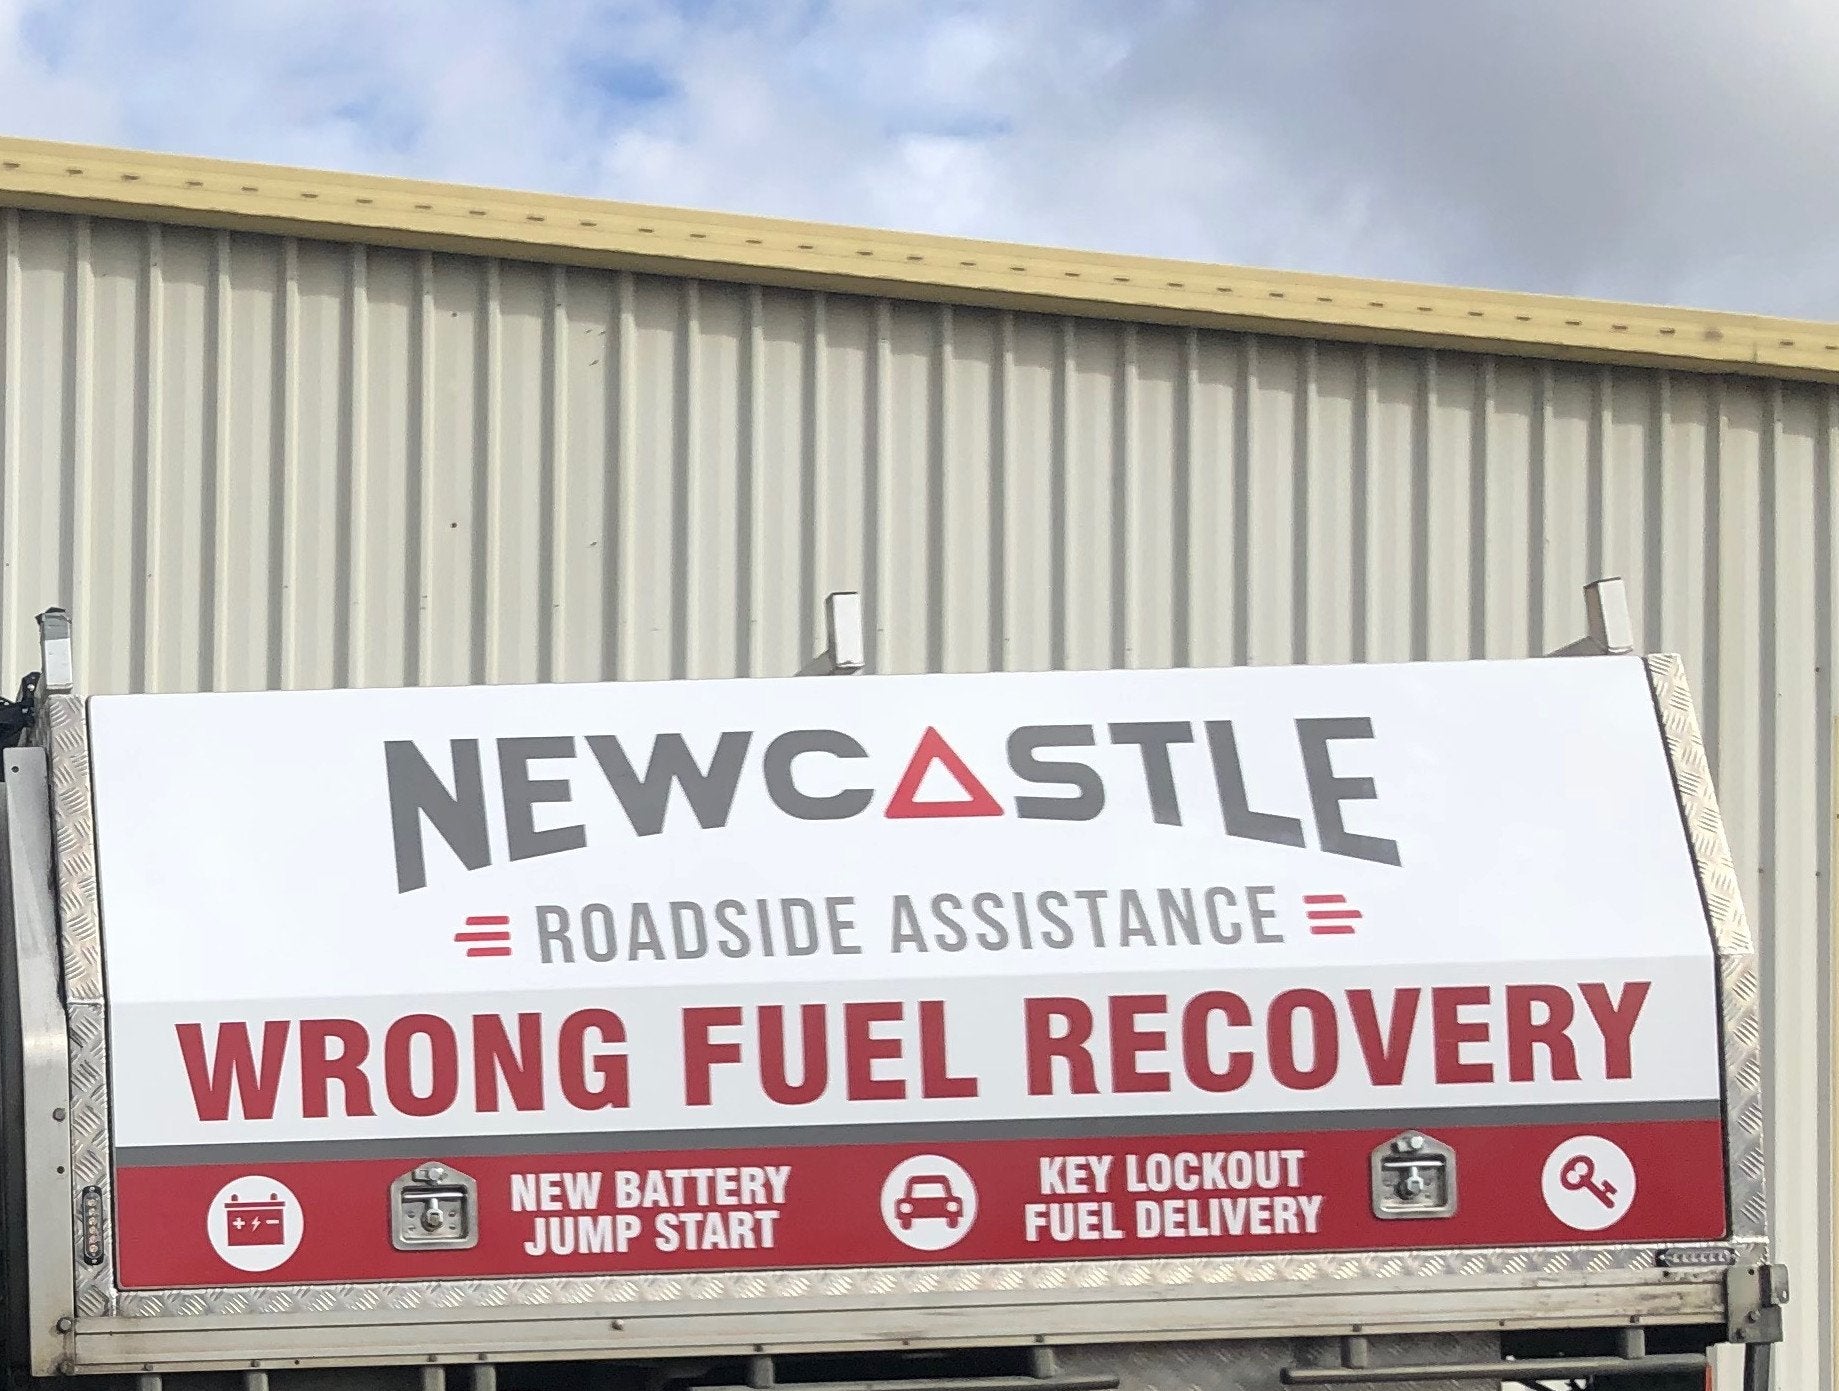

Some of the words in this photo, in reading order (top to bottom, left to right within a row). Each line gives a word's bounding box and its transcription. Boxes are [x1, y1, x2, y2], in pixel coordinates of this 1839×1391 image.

[384, 717, 1402, 894] NEWCASTLE
[535, 897, 862, 963] ROADSIDE
[891, 886, 1285, 953] ASSISTANCE
[175, 1009, 629, 1121] WRONG
[682, 1001, 978, 1106] FUEL
[1024, 982, 1652, 1097] RECOVERY
[511, 1172, 604, 1212] NEW
[615, 1166, 791, 1209] BATTERY
[1040, 1155, 1113, 1194] KEY
[1126, 1150, 1304, 1192] LOCKOUT
[524, 1215, 641, 1255] JUMP
[655, 1210, 779, 1251] START
[1025, 1202, 1124, 1241] FUEL
[1136, 1195, 1322, 1238] DELIVERY
